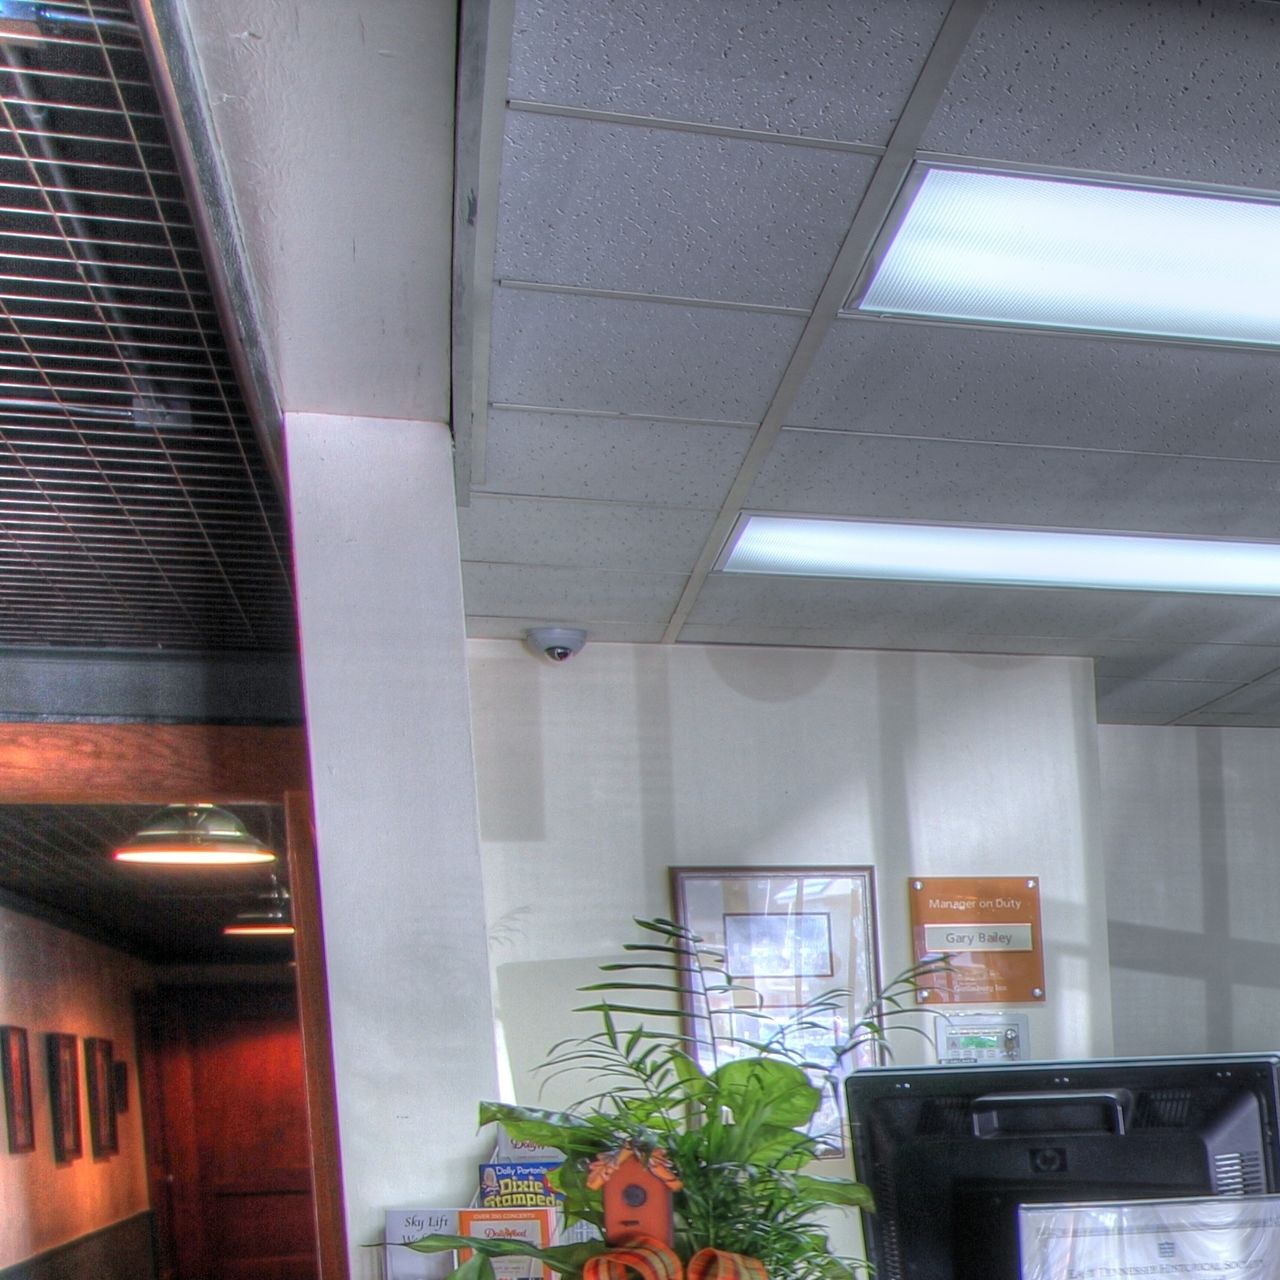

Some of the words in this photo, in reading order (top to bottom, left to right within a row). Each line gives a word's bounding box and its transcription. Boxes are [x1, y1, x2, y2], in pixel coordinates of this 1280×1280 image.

[928, 898, 976, 910] Manager
[979, 900, 993, 908] on
[995, 898, 1022, 910] Duty
[945, 932, 974, 946] Gary
[978, 932, 1013, 945] Bailey
[495, 1166, 516, 1176] Dolly
[499, 1175, 545, 1195] Dixie
[404, 1214, 424, 1232] Sky
[428, 1214, 448, 1231] Lift
